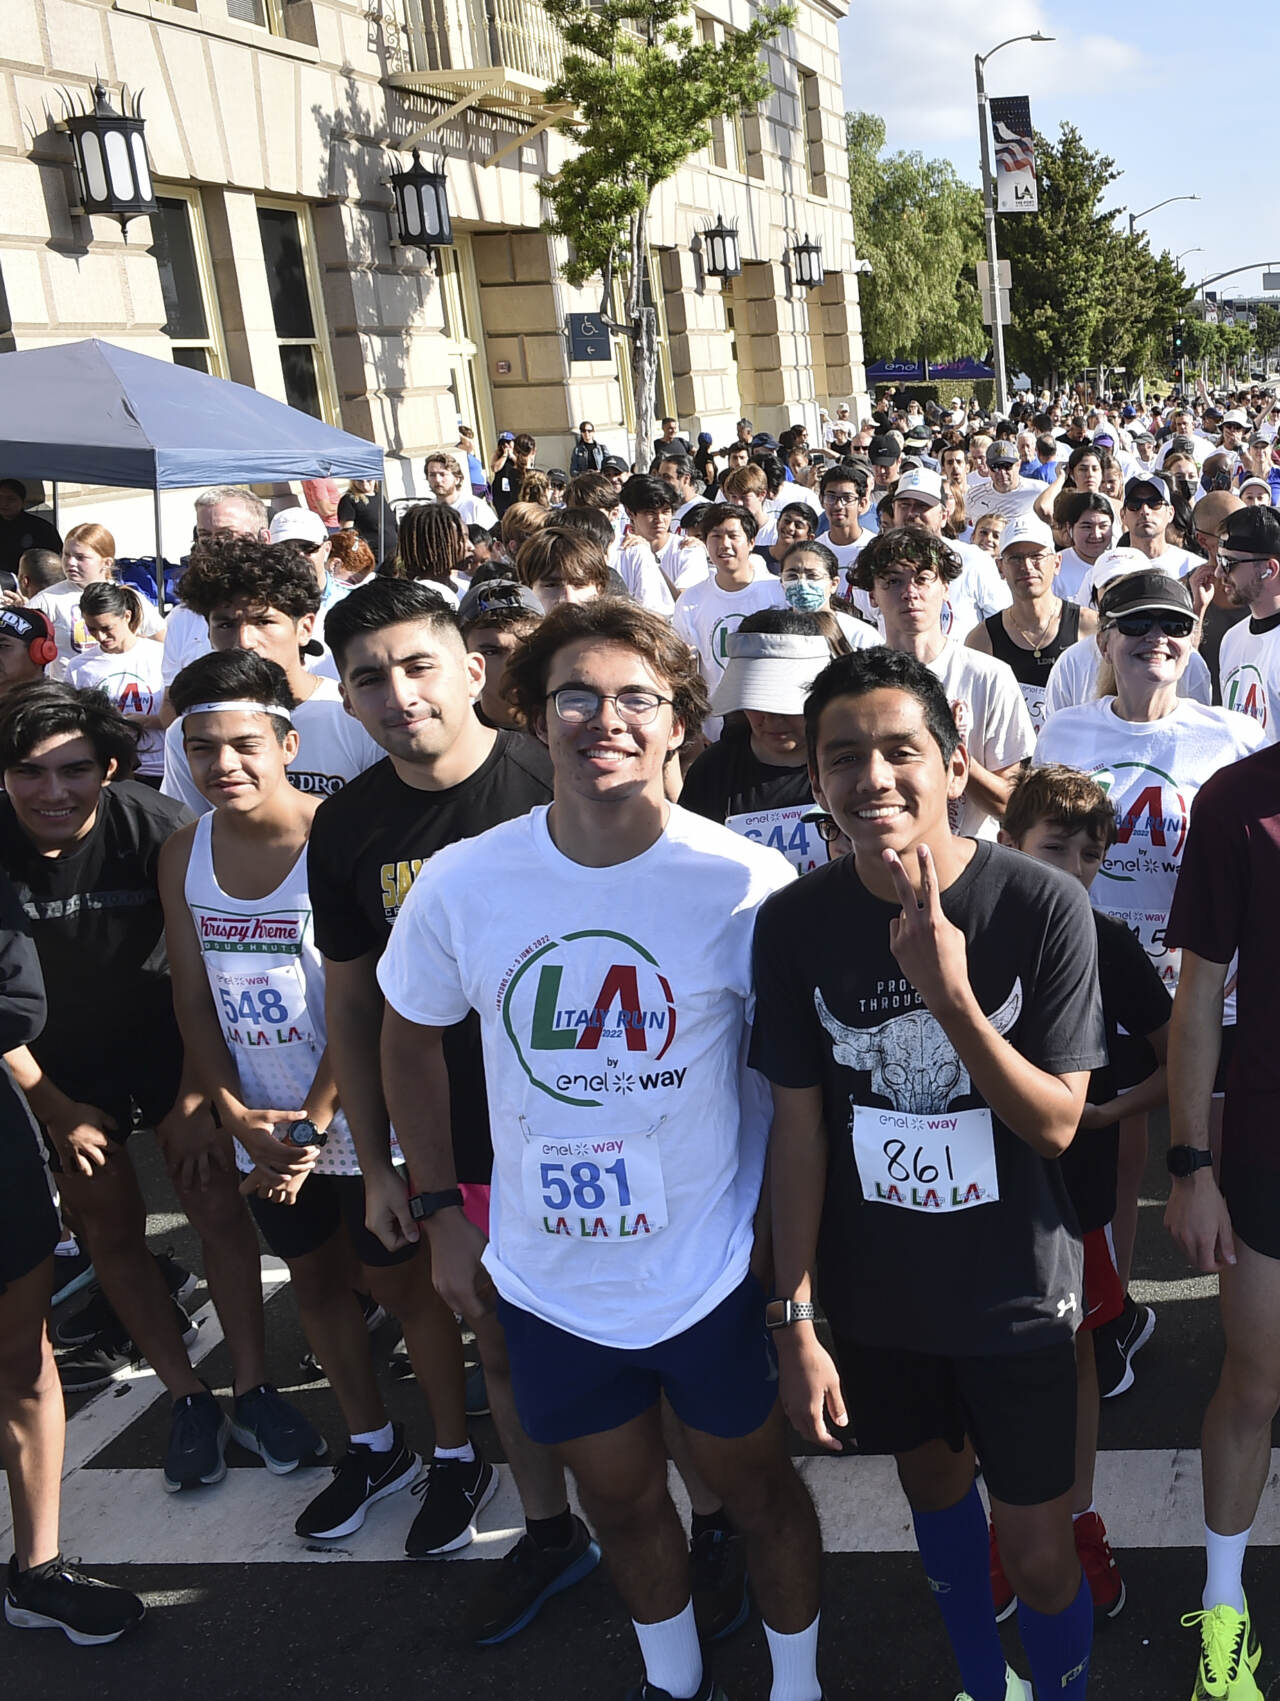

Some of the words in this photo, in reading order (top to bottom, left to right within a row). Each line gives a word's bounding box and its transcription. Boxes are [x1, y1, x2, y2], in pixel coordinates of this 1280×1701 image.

[884, 363, 919, 371] enel
[287, 774, 345, 795] EDRO
[745, 813, 770, 826] enel
[781, 810, 802, 821] way
[1145, 815, 1181, 832] RUN
[1132, 829, 1150, 837] 2022
[1138, 847, 1148, 857] by
[1102, 857, 1141, 872] enel
[1145, 913, 1166, 924] way
[200, 915, 252, 942] Krispy
[250, 917, 300, 940] Kreme
[204, 941, 298, 953] DOUGHNUTS
[245, 975, 270, 987] way
[218, 987, 289, 1025] 548
[530, 964, 648, 1052] LA
[859, 992, 924, 1012] THROUG
[555, 1008, 611, 1029] ITALY
[616, 1009, 666, 1030] RUN
[247, 1031, 270, 1046] LA
[276, 1026, 303, 1044] LA
[602, 1028, 624, 1038] 2022
[606, 1056, 619, 1069] by
[556, 1071, 610, 1093] enel
[638, 1066, 688, 1091] way
[879, 1113, 909, 1129] enel
[926, 1117, 959, 1131] way
[542, 1143, 574, 1156] enel
[591, 1139, 625, 1155] way
[882, 1138, 954, 1184] 861
[540, 1157, 632, 1211] 581
[874, 1181, 904, 1204] LA
[911, 1187, 941, 1208] LA
[951, 1182, 982, 1207] LA
[543, 1216, 573, 1237] LA
[580, 1217, 609, 1238] LA
[619, 1212, 651, 1237] LA
